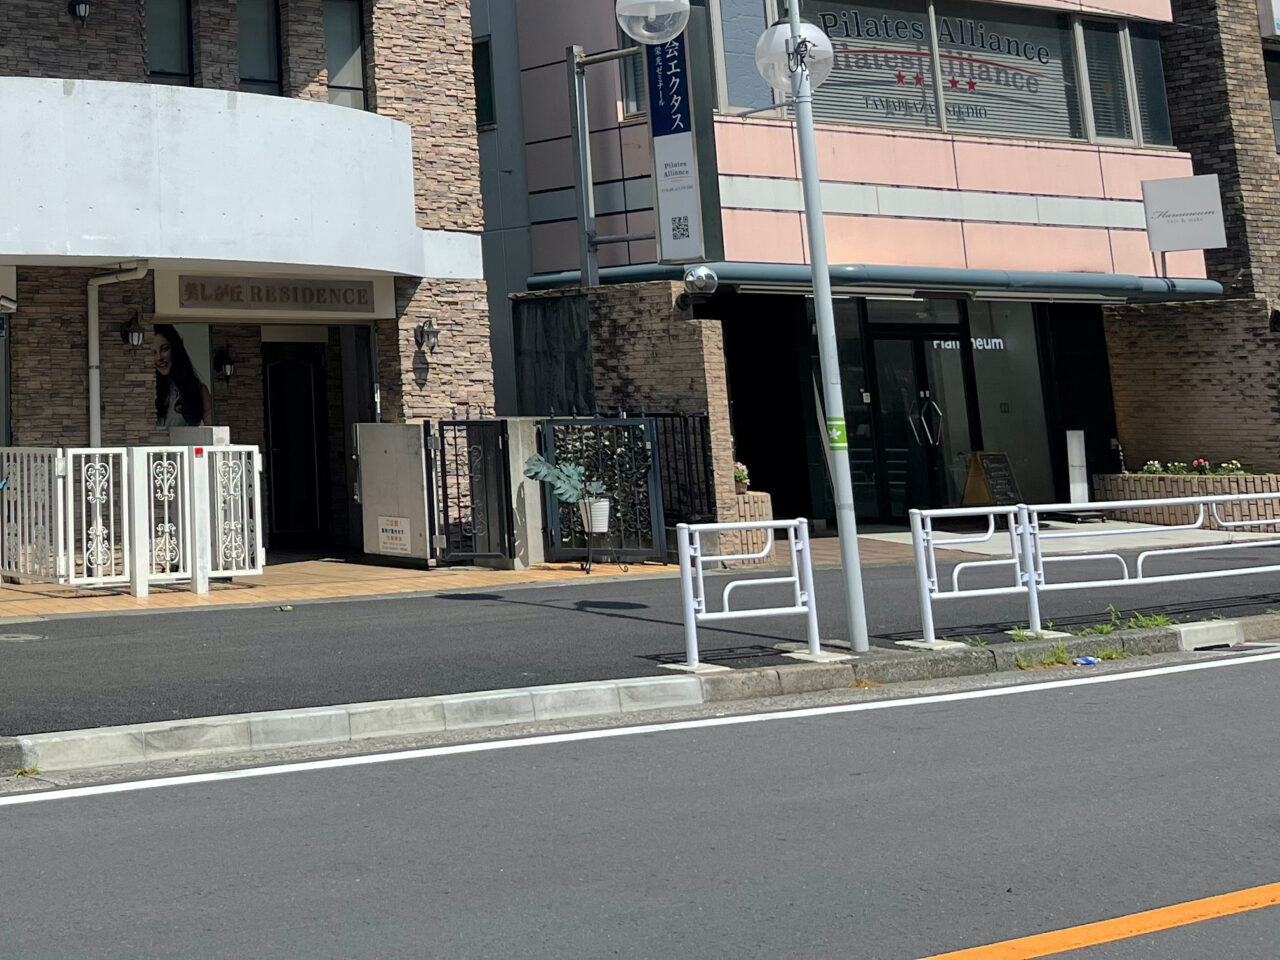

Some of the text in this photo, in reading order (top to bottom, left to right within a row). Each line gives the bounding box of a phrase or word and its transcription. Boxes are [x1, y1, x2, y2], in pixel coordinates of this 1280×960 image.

[819, 9, 1050, 65] Pilates Alliance
[664, 40, 684, 131] 会エクタス
[664, 170, 690, 178] Alliance
[250, 285, 369, 305] RESIDENCE
